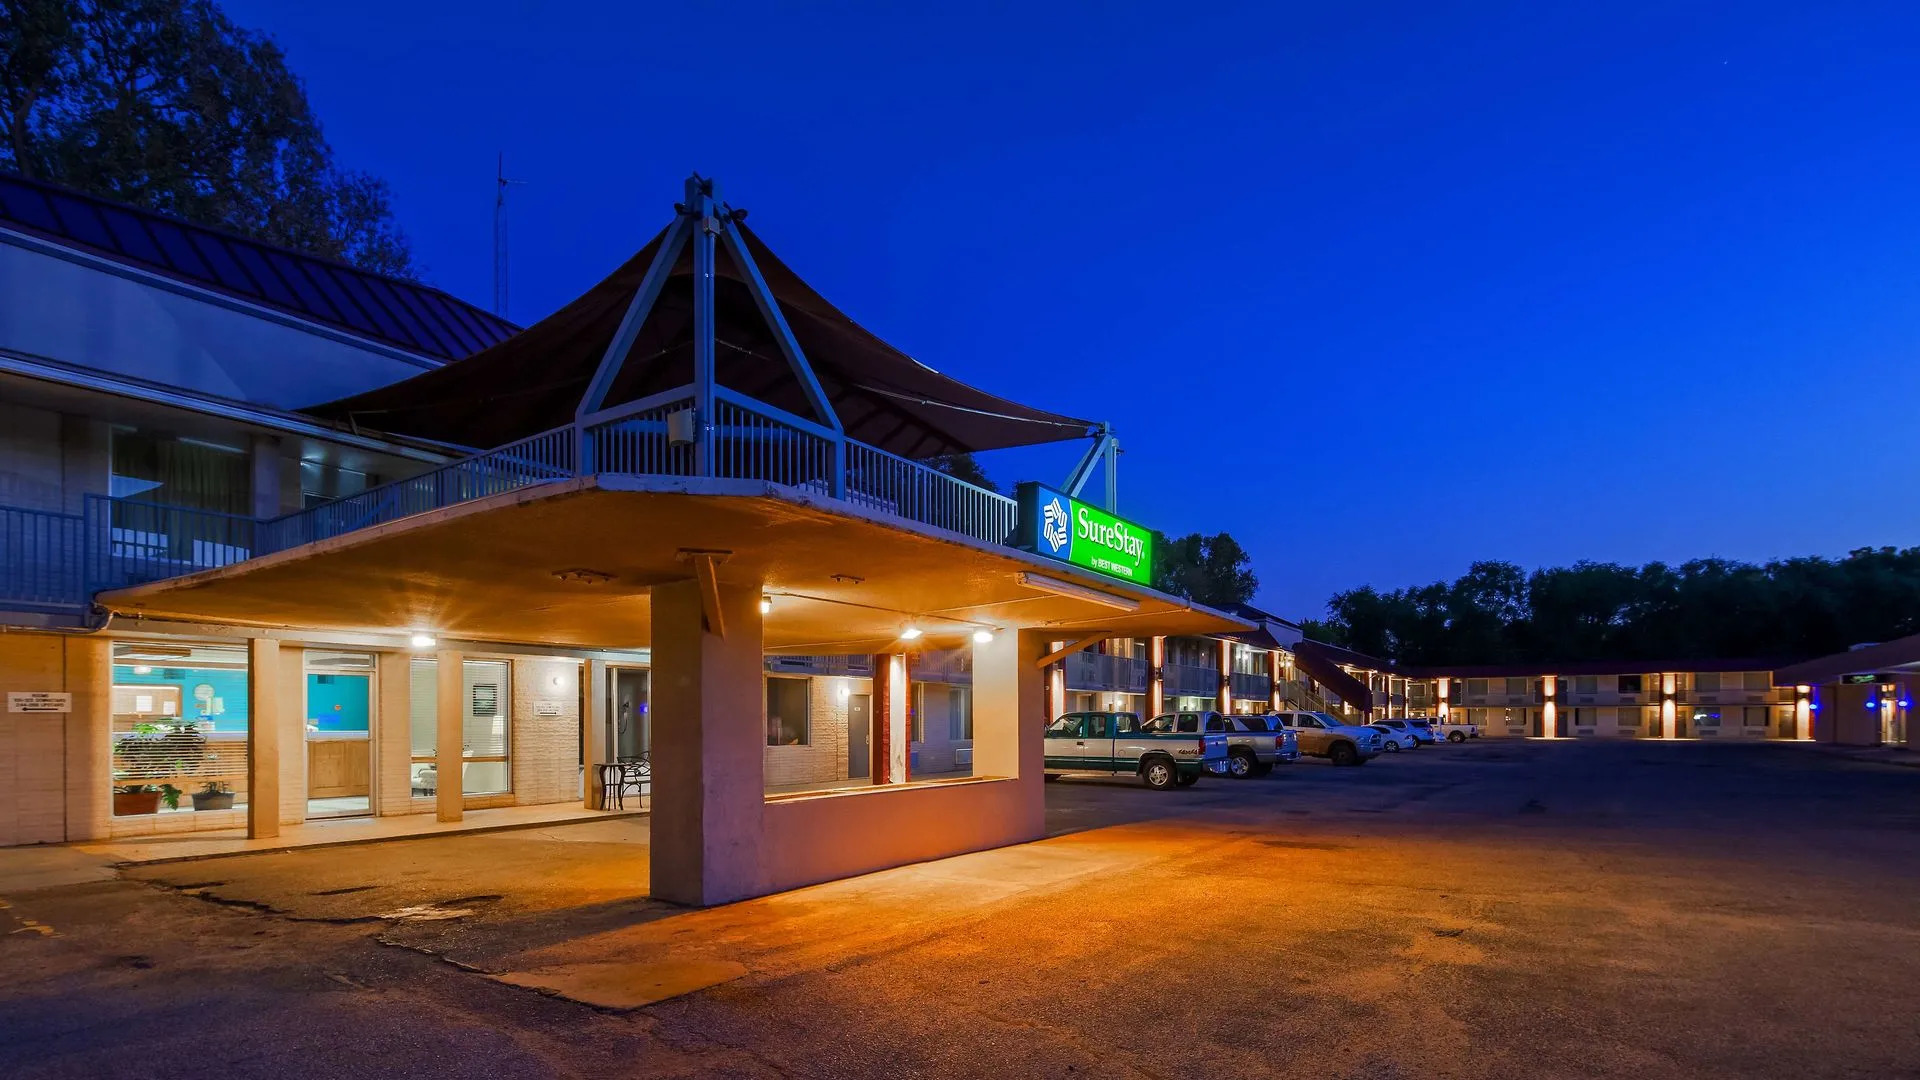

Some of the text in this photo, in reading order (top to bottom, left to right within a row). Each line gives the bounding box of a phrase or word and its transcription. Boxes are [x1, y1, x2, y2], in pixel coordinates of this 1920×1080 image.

[1078, 508, 1143, 566] SureStay
[1091, 557, 1132, 576] by BEST WESTERN
